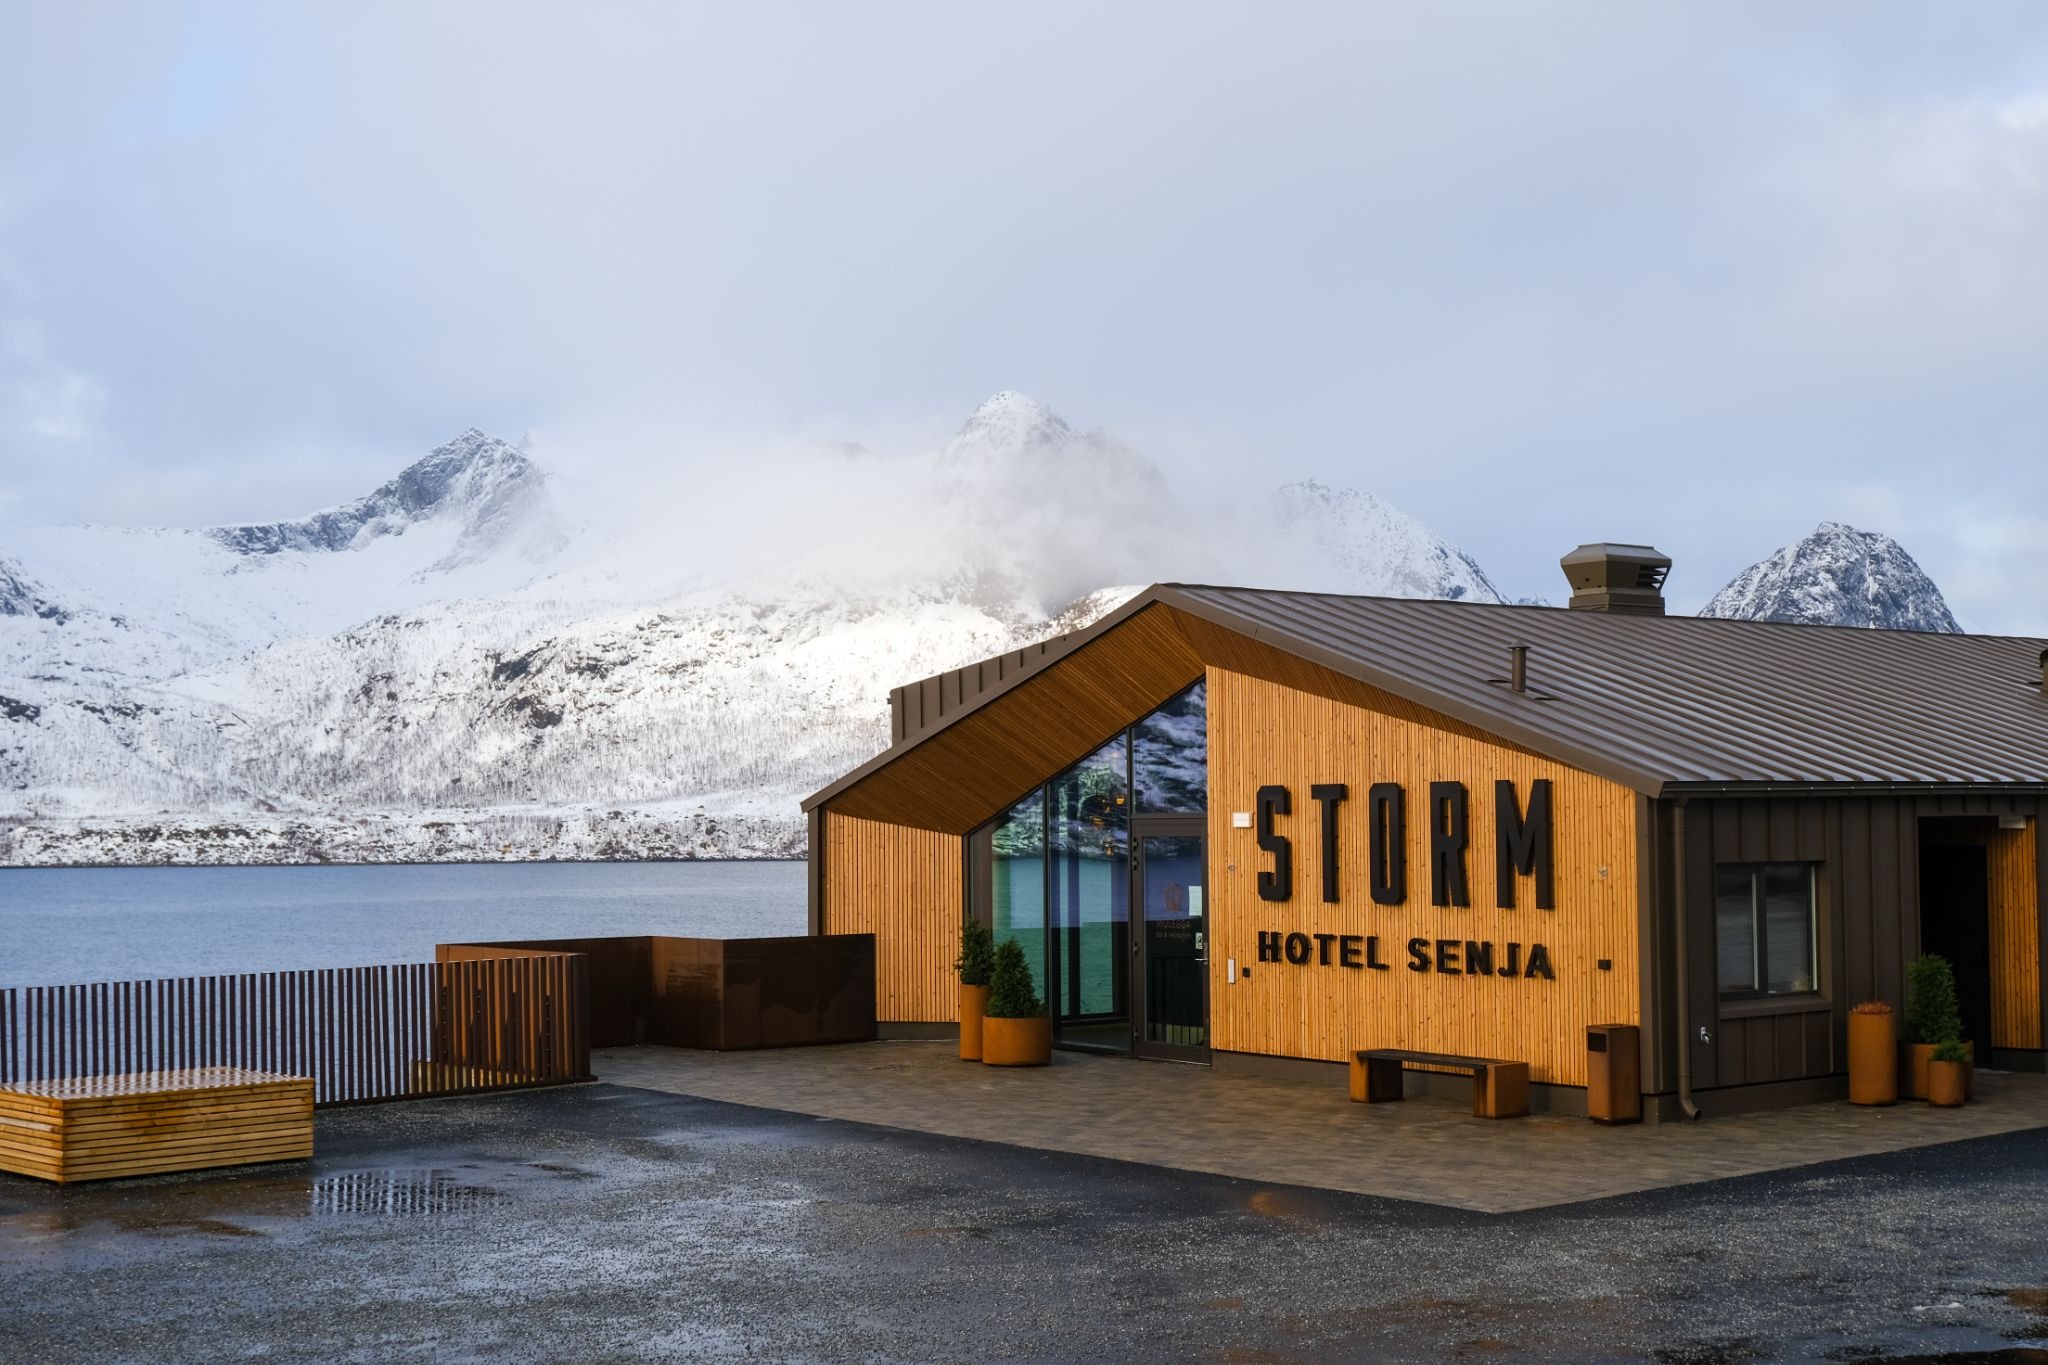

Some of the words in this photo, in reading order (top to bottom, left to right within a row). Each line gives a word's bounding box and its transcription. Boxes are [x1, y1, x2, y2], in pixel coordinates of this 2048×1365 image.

[1257, 779, 1555, 909] STORM
[1258, 931, 1390, 970] HOTEL
[1407, 937, 1555, 980] SENJA
